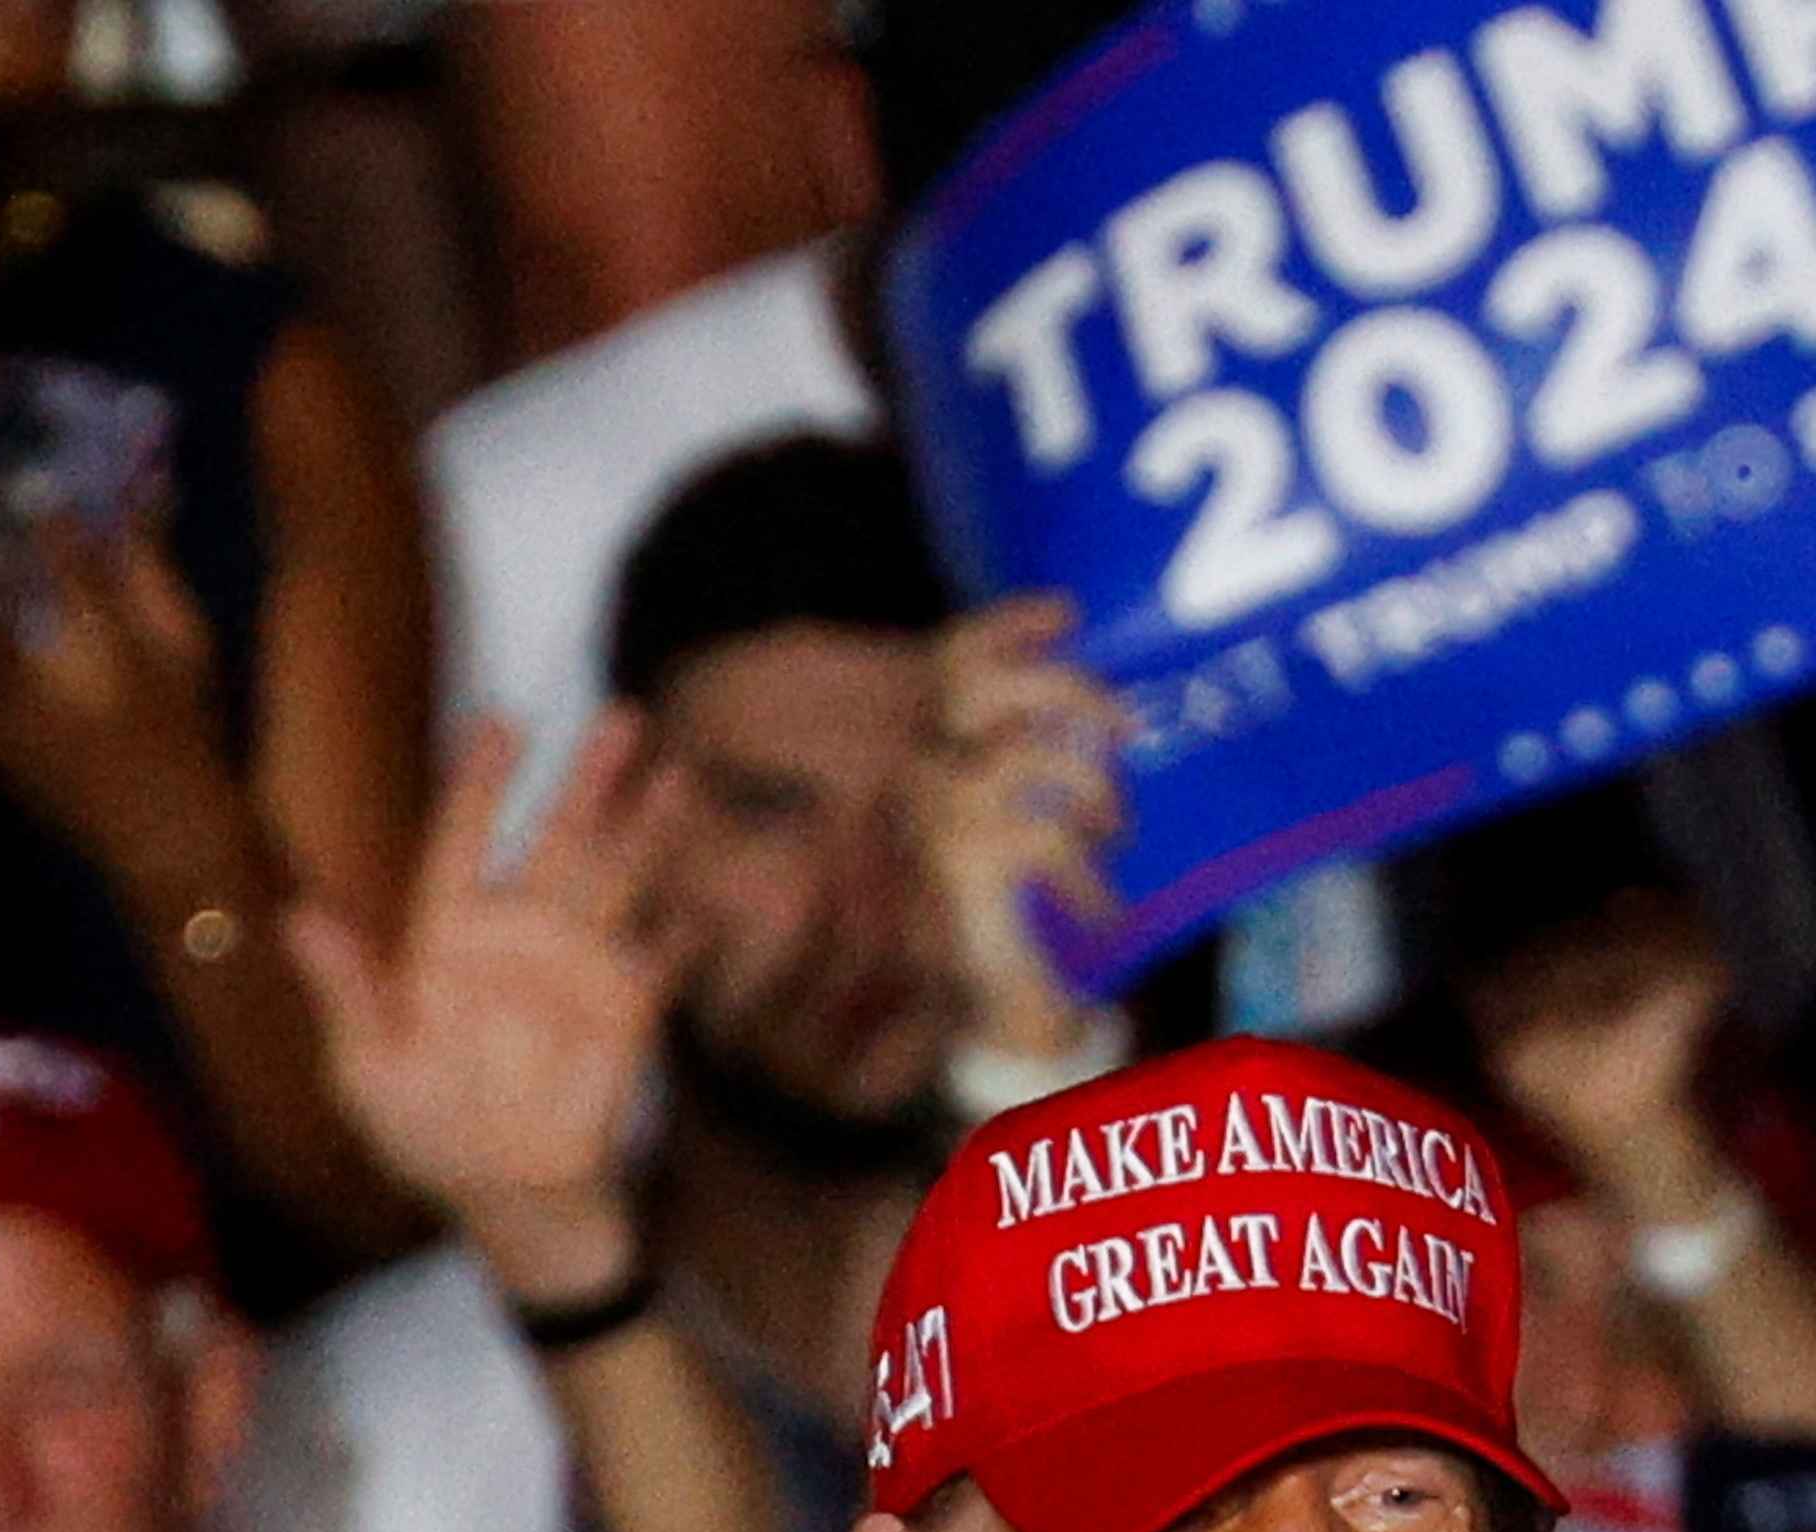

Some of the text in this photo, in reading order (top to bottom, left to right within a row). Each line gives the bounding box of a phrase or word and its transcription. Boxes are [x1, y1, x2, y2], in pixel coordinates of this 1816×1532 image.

[1116, 635, 1296, 768] EXT
[1298, 487, 1641, 689] TRUMP
[990, 1092, 1497, 1230] MAKE AMERICA
[1050, 1212, 1476, 1334] GREAT AGAIN
